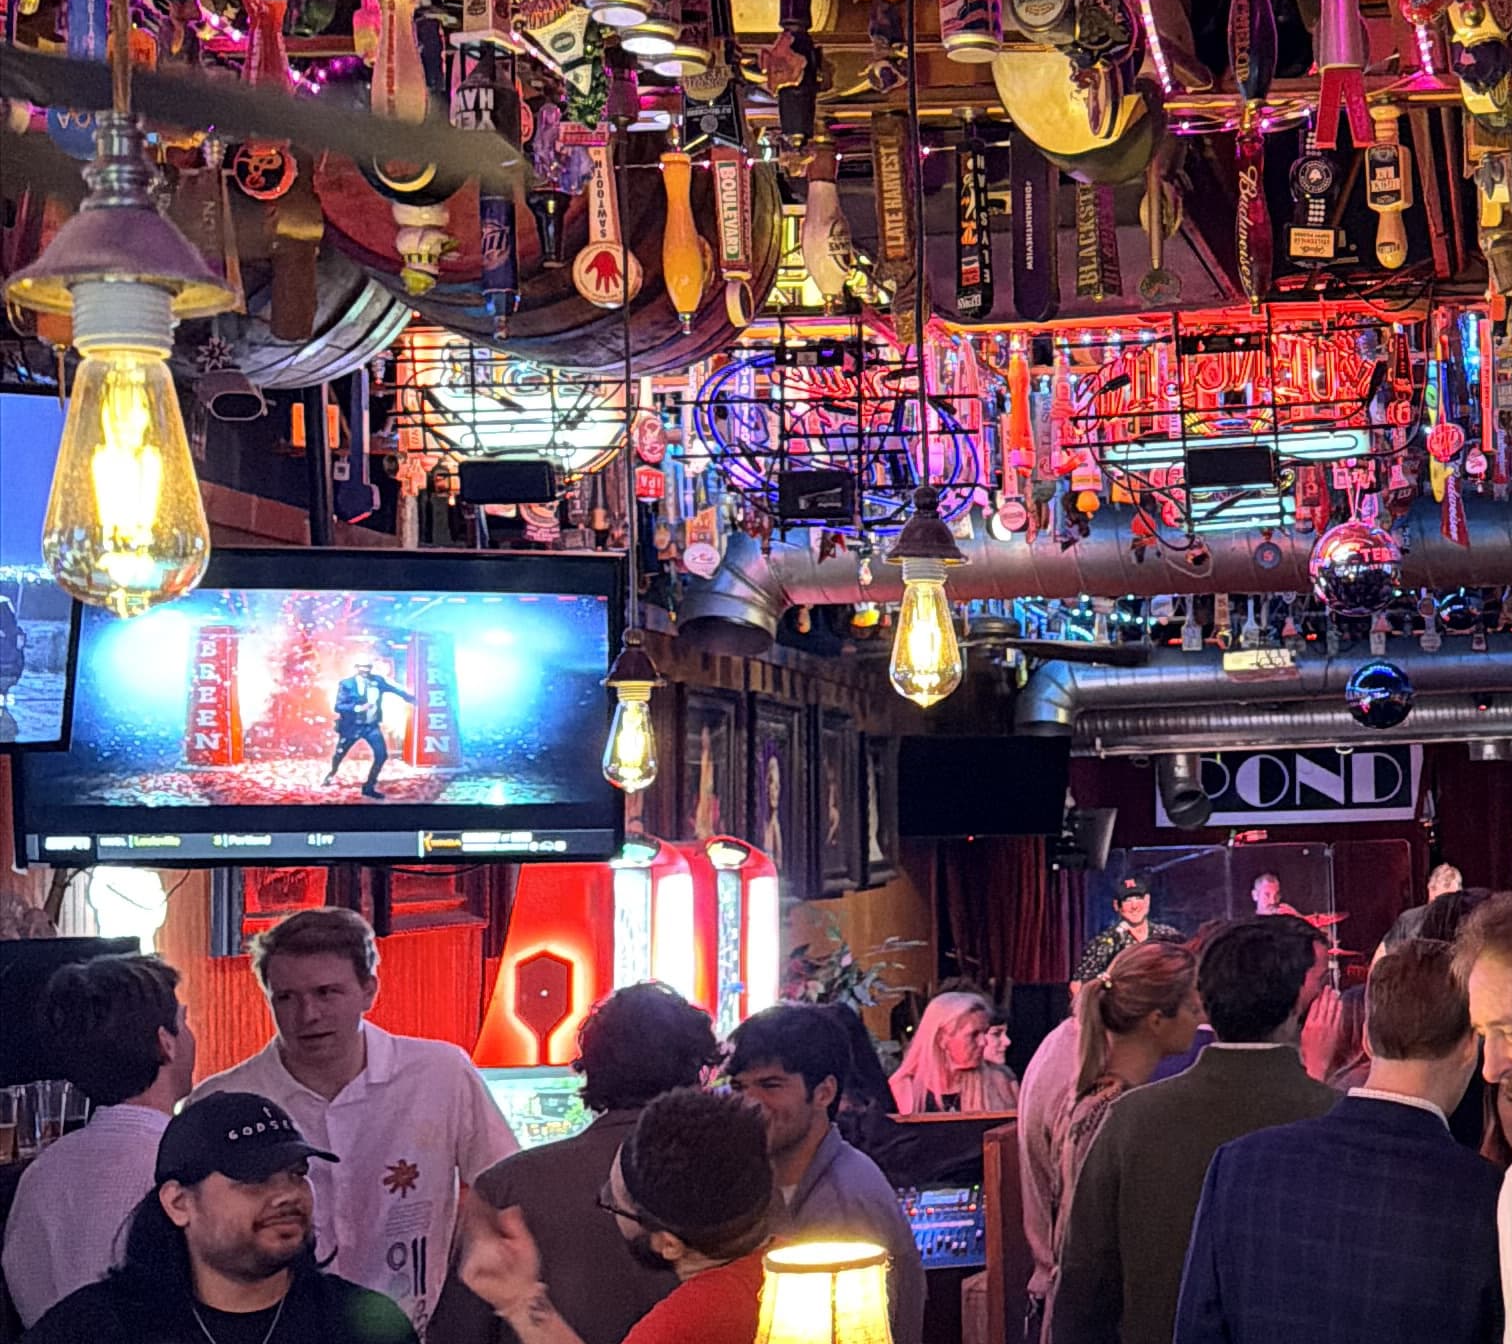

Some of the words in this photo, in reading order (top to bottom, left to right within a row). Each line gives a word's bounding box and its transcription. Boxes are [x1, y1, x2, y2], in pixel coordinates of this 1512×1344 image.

[593, 159, 607, 239] SAWTOOTH
[719, 166, 740, 256] BOULEVARD
[880, 146, 903, 209] HARVEST
[976, 153, 991, 284] ELYSIAN
[884, 212, 906, 246] LATE
[1235, 164, 1258, 295] Budweiser
